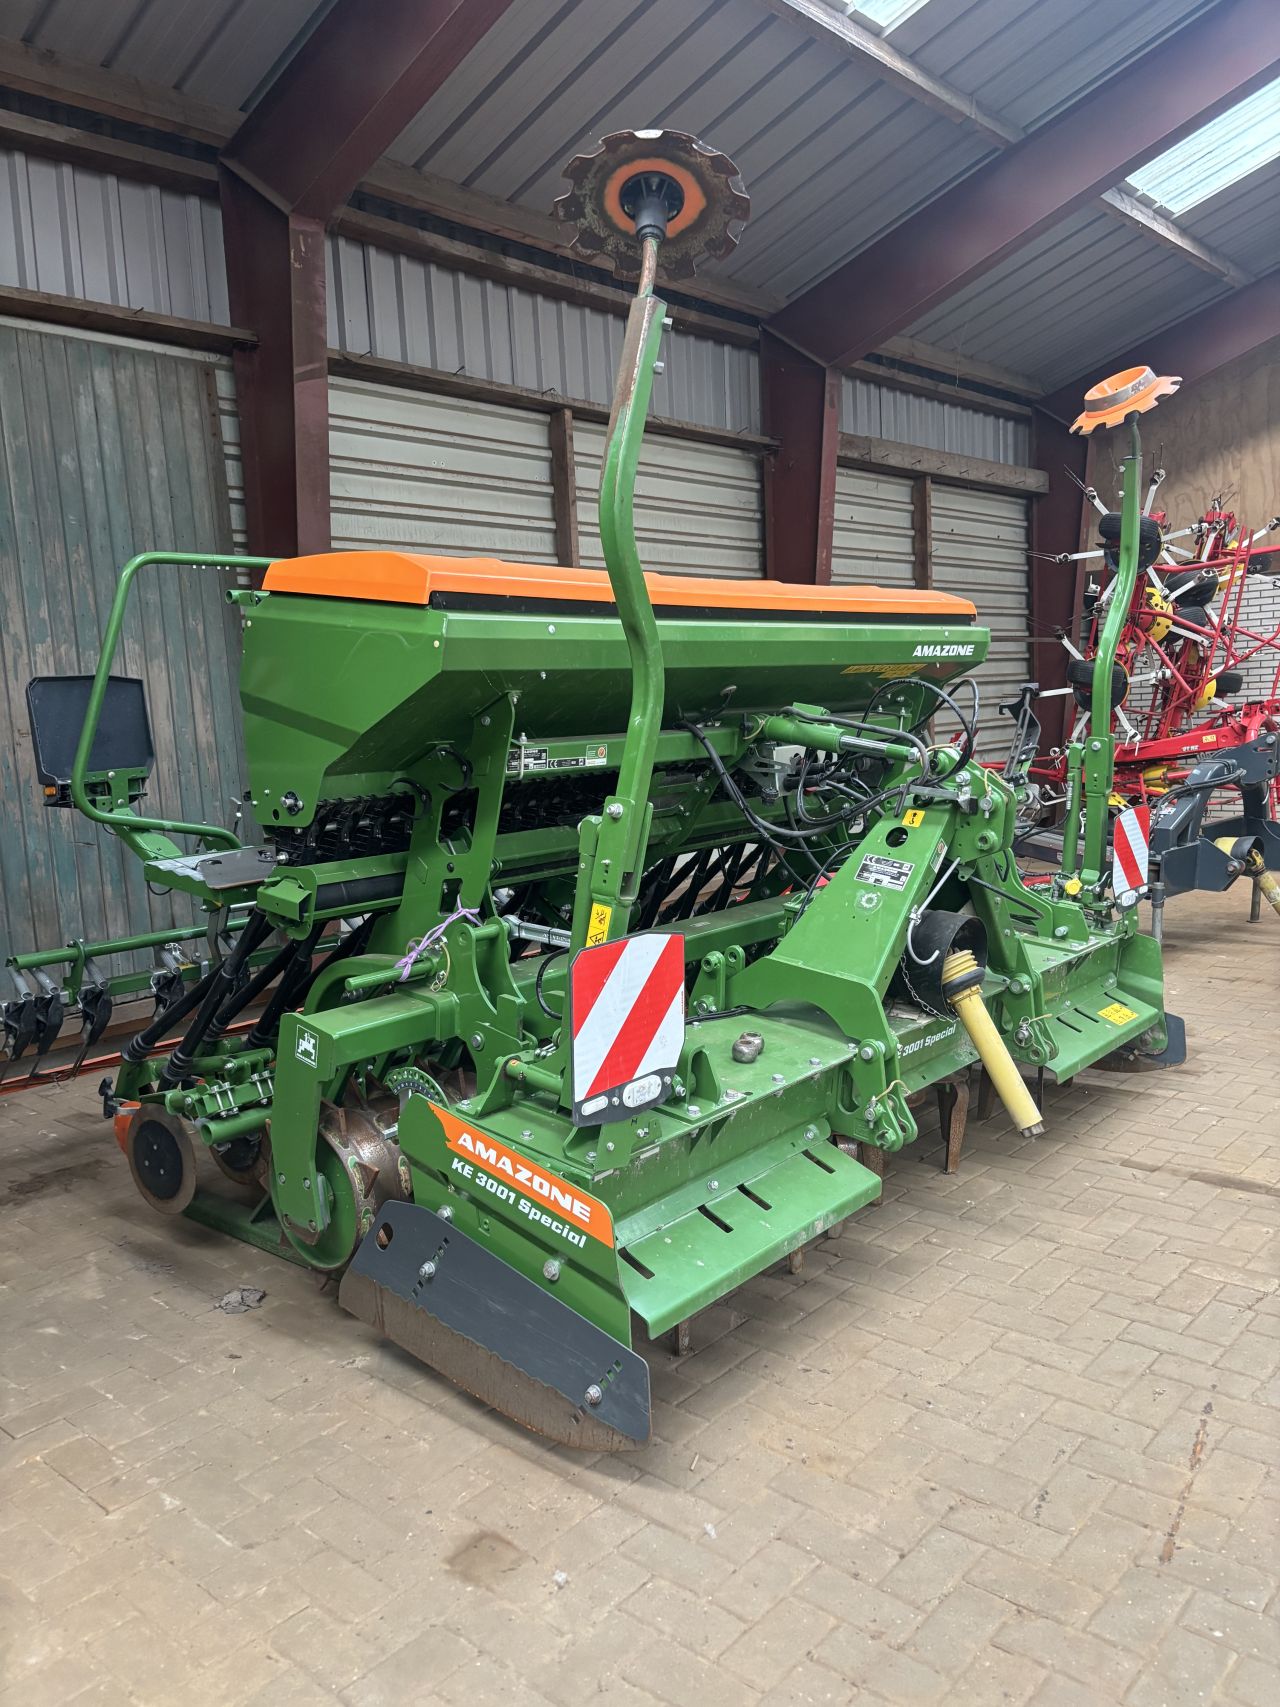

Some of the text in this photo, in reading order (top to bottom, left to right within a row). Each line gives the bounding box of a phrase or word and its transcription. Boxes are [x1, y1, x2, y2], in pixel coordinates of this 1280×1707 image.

[912, 644, 975, 657] AMAZONE
[902, 1038, 925, 1057] 3001
[924, 1023, 957, 1047] Special
[451, 1157, 588, 1249] KE 3001 Special
[457, 1132, 592, 1223] AMAZONE
